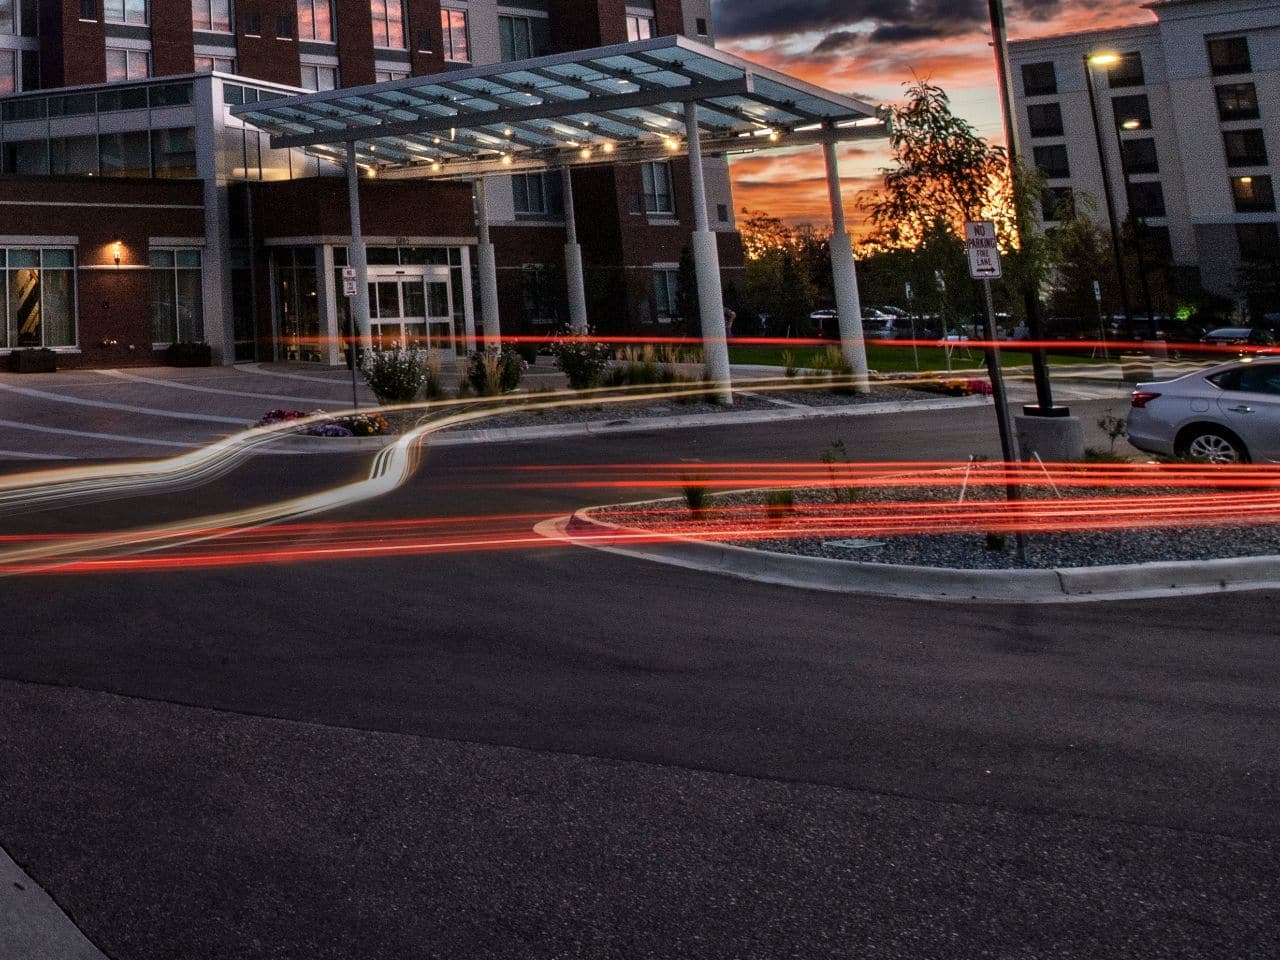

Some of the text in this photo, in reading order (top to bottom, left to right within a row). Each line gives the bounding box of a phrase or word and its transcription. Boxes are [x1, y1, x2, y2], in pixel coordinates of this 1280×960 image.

[974, 225, 985, 236] NO
[969, 237, 996, 249] PARKING
[977, 258, 992, 266] LANE
